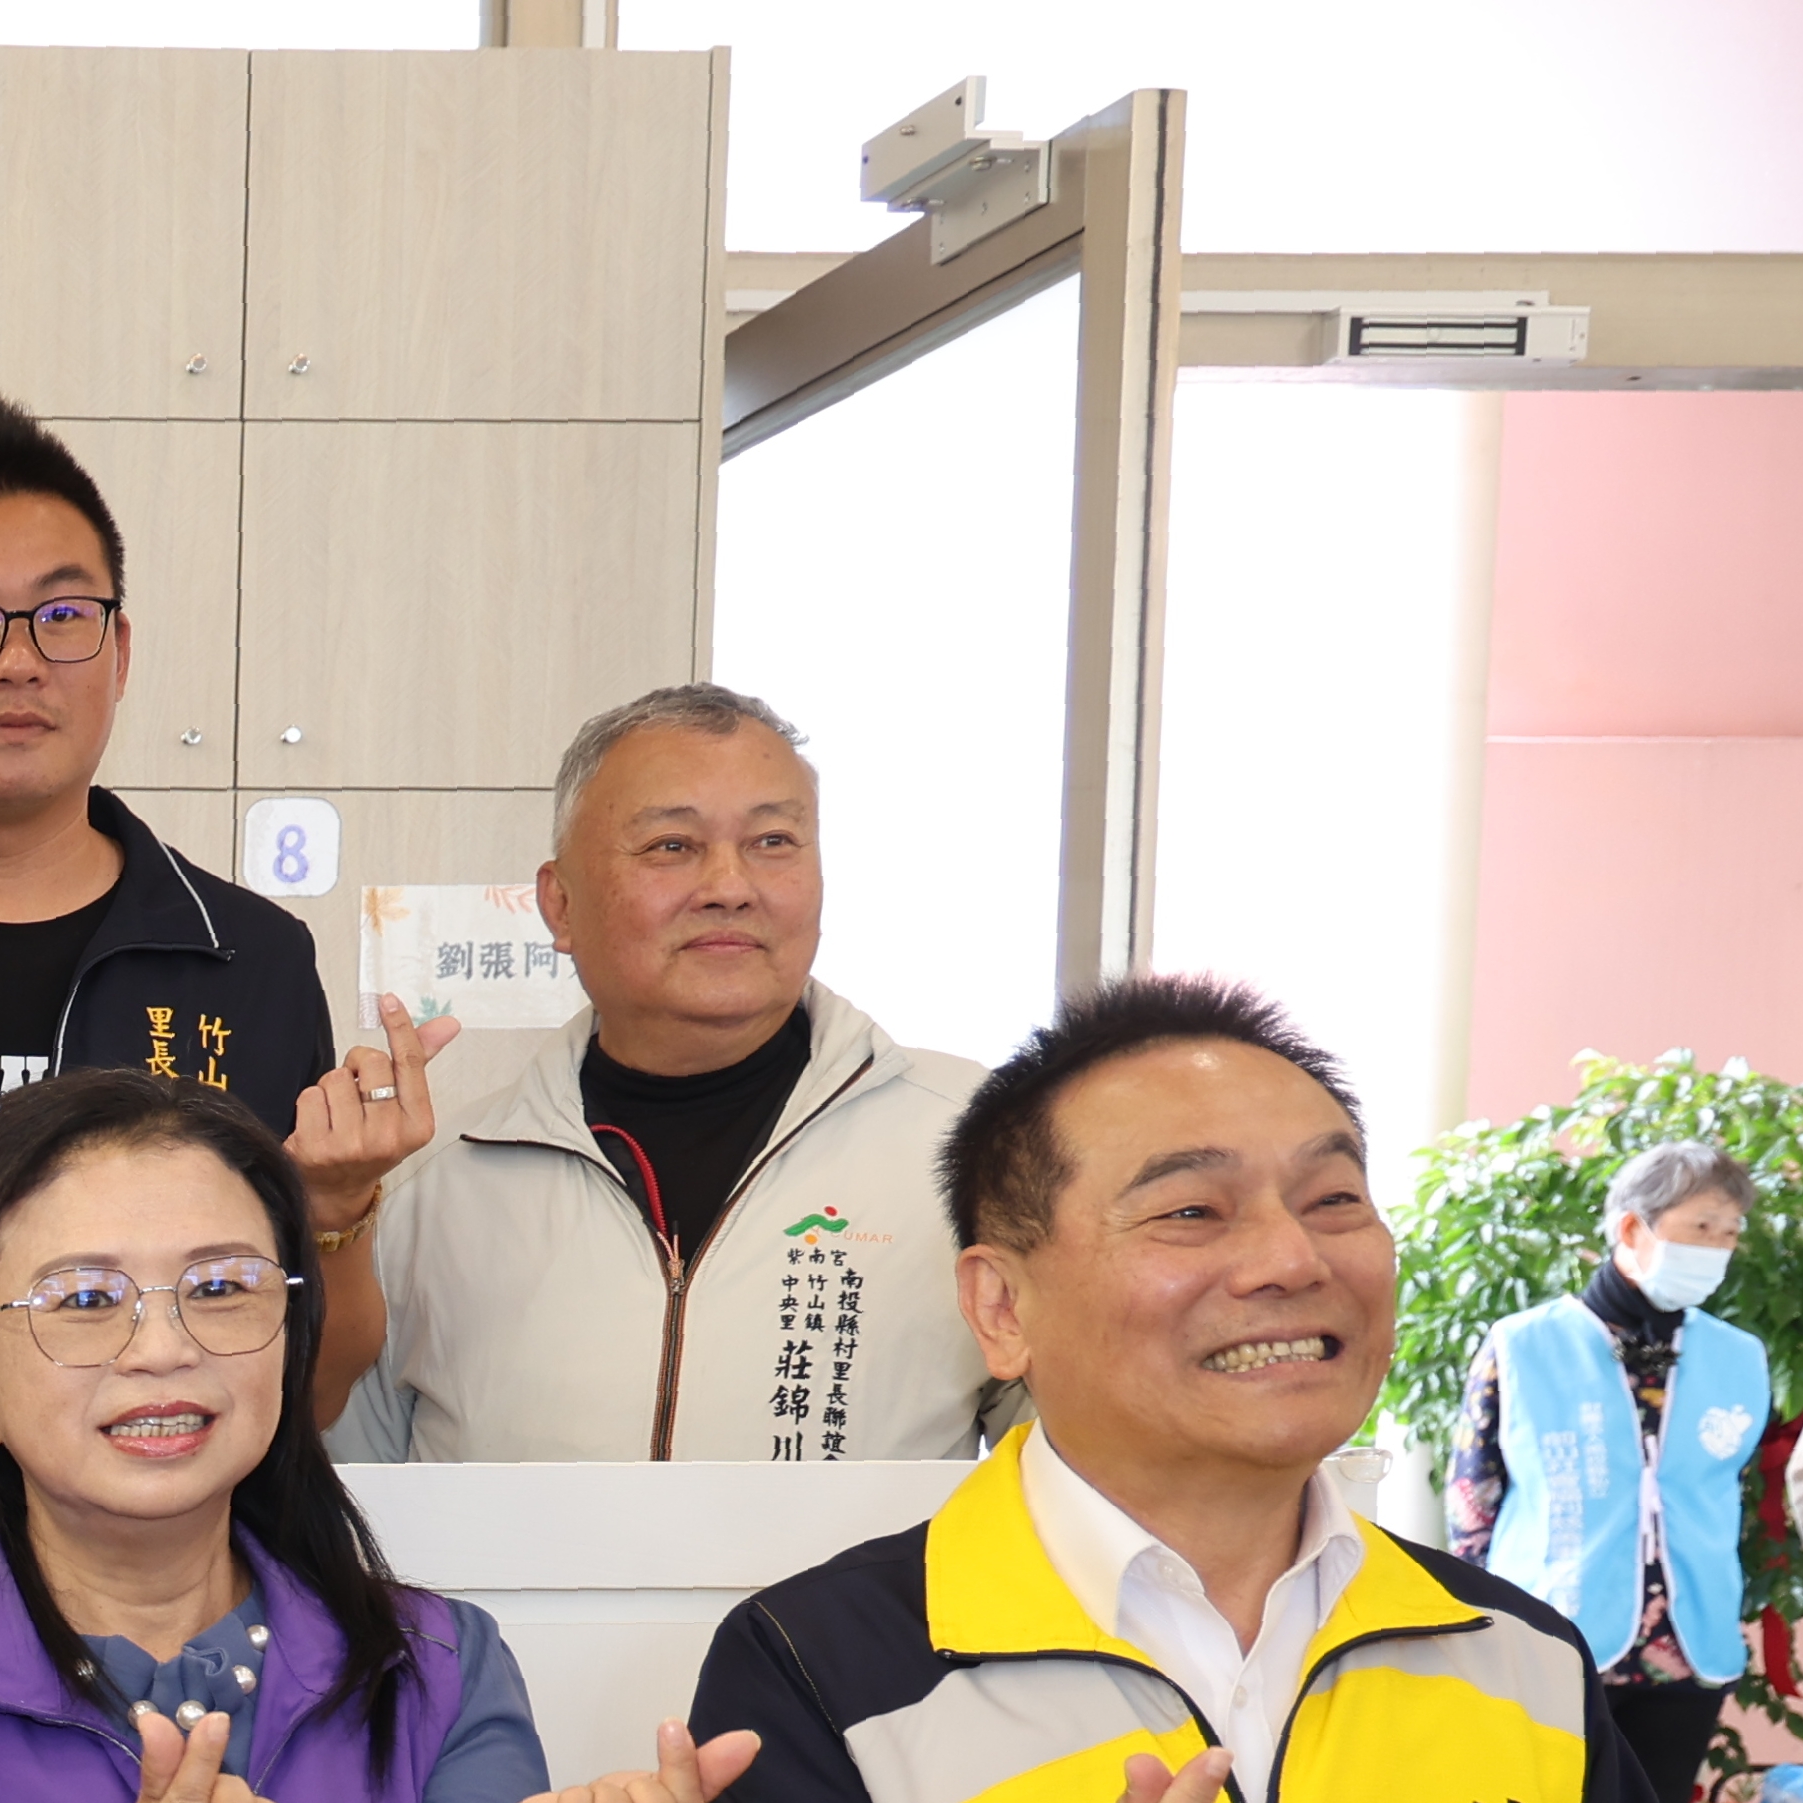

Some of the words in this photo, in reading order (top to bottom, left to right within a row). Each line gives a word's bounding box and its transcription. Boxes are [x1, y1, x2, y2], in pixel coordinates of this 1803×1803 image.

[272, 823, 310, 884] 8
[435, 940, 578, 981] 劉張阿
[145, 1006, 180, 1079] 里長
[198, 1013, 232, 1092] 竹山
[778, 1273, 800, 1331] 中央里
[804, 1273, 829, 1333] 竹山鎮
[821, 1267, 865, 1461] 南投縣村里長聯誼
[769, 1339, 814, 1461] 莊錦川
